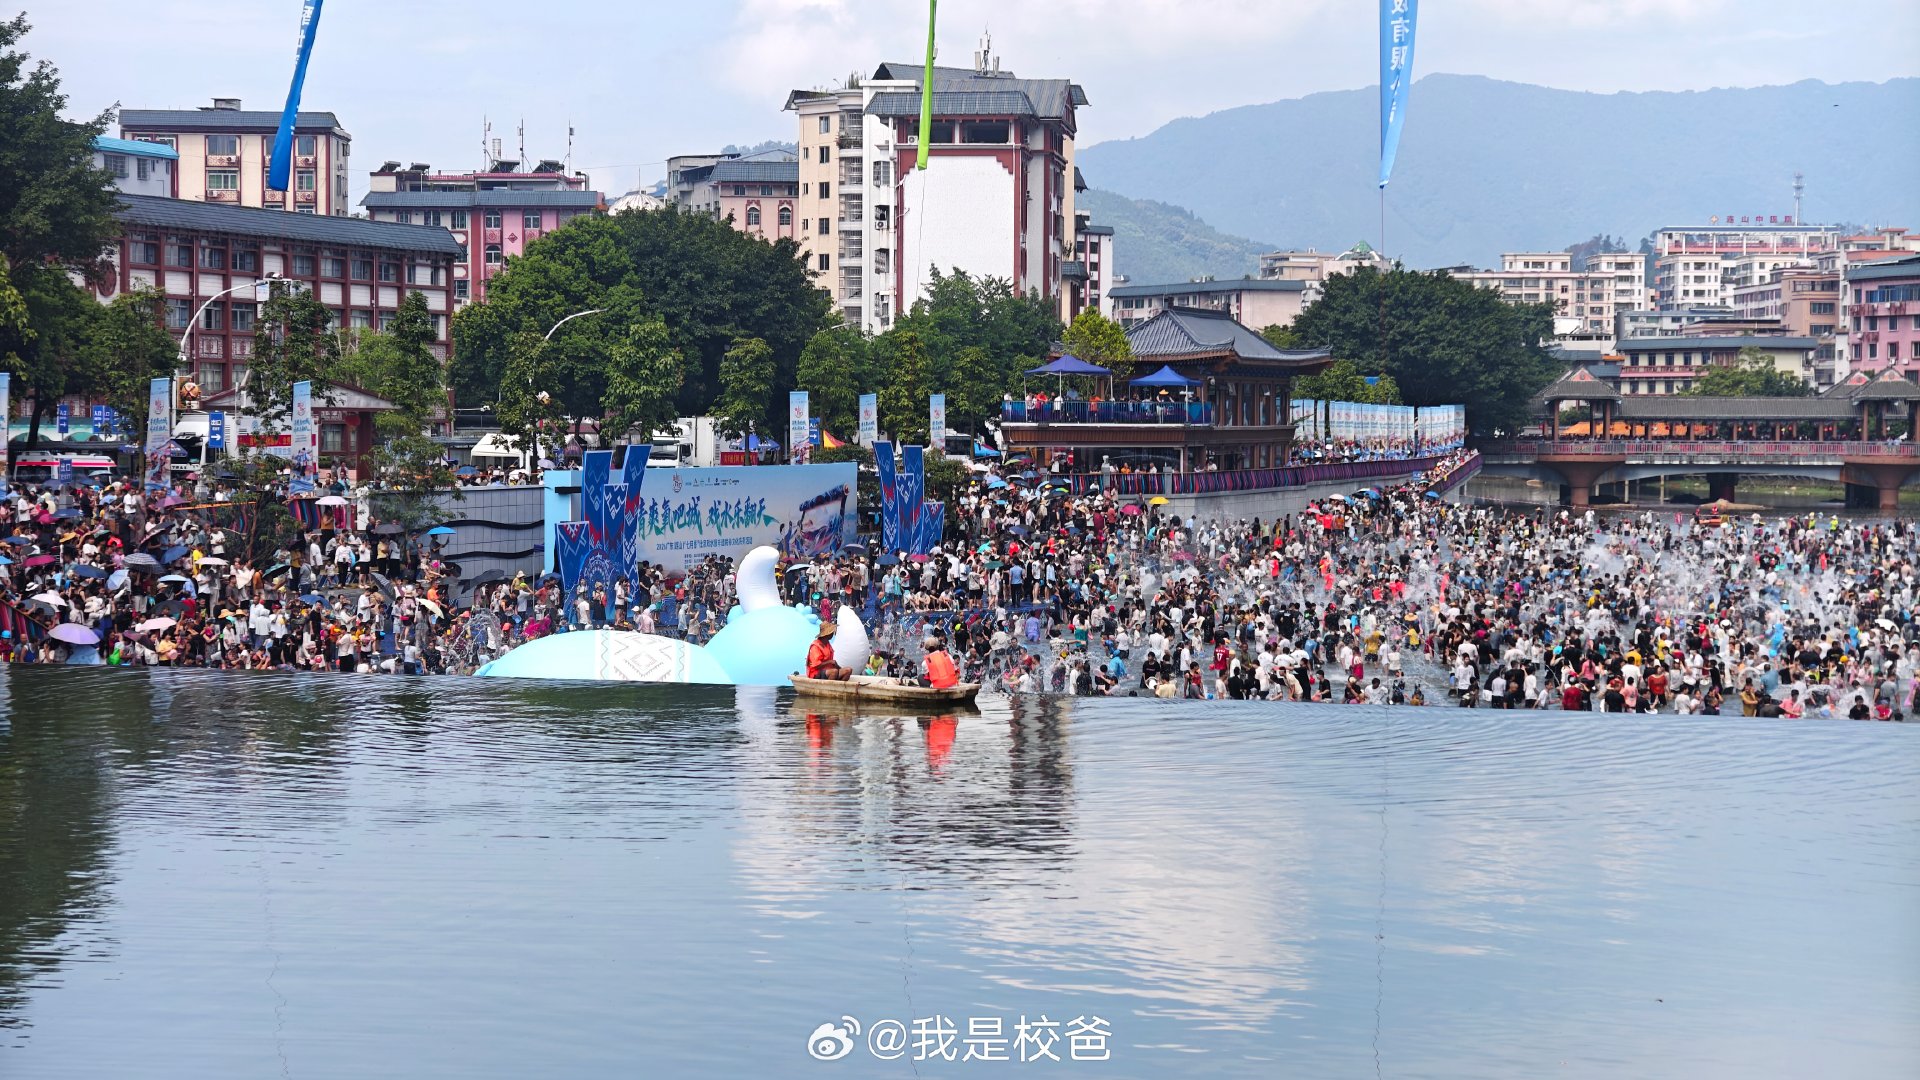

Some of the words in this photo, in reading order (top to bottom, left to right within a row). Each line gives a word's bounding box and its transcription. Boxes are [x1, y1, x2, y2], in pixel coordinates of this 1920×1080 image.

[705, 496, 780, 536] 戏水乐翻天
